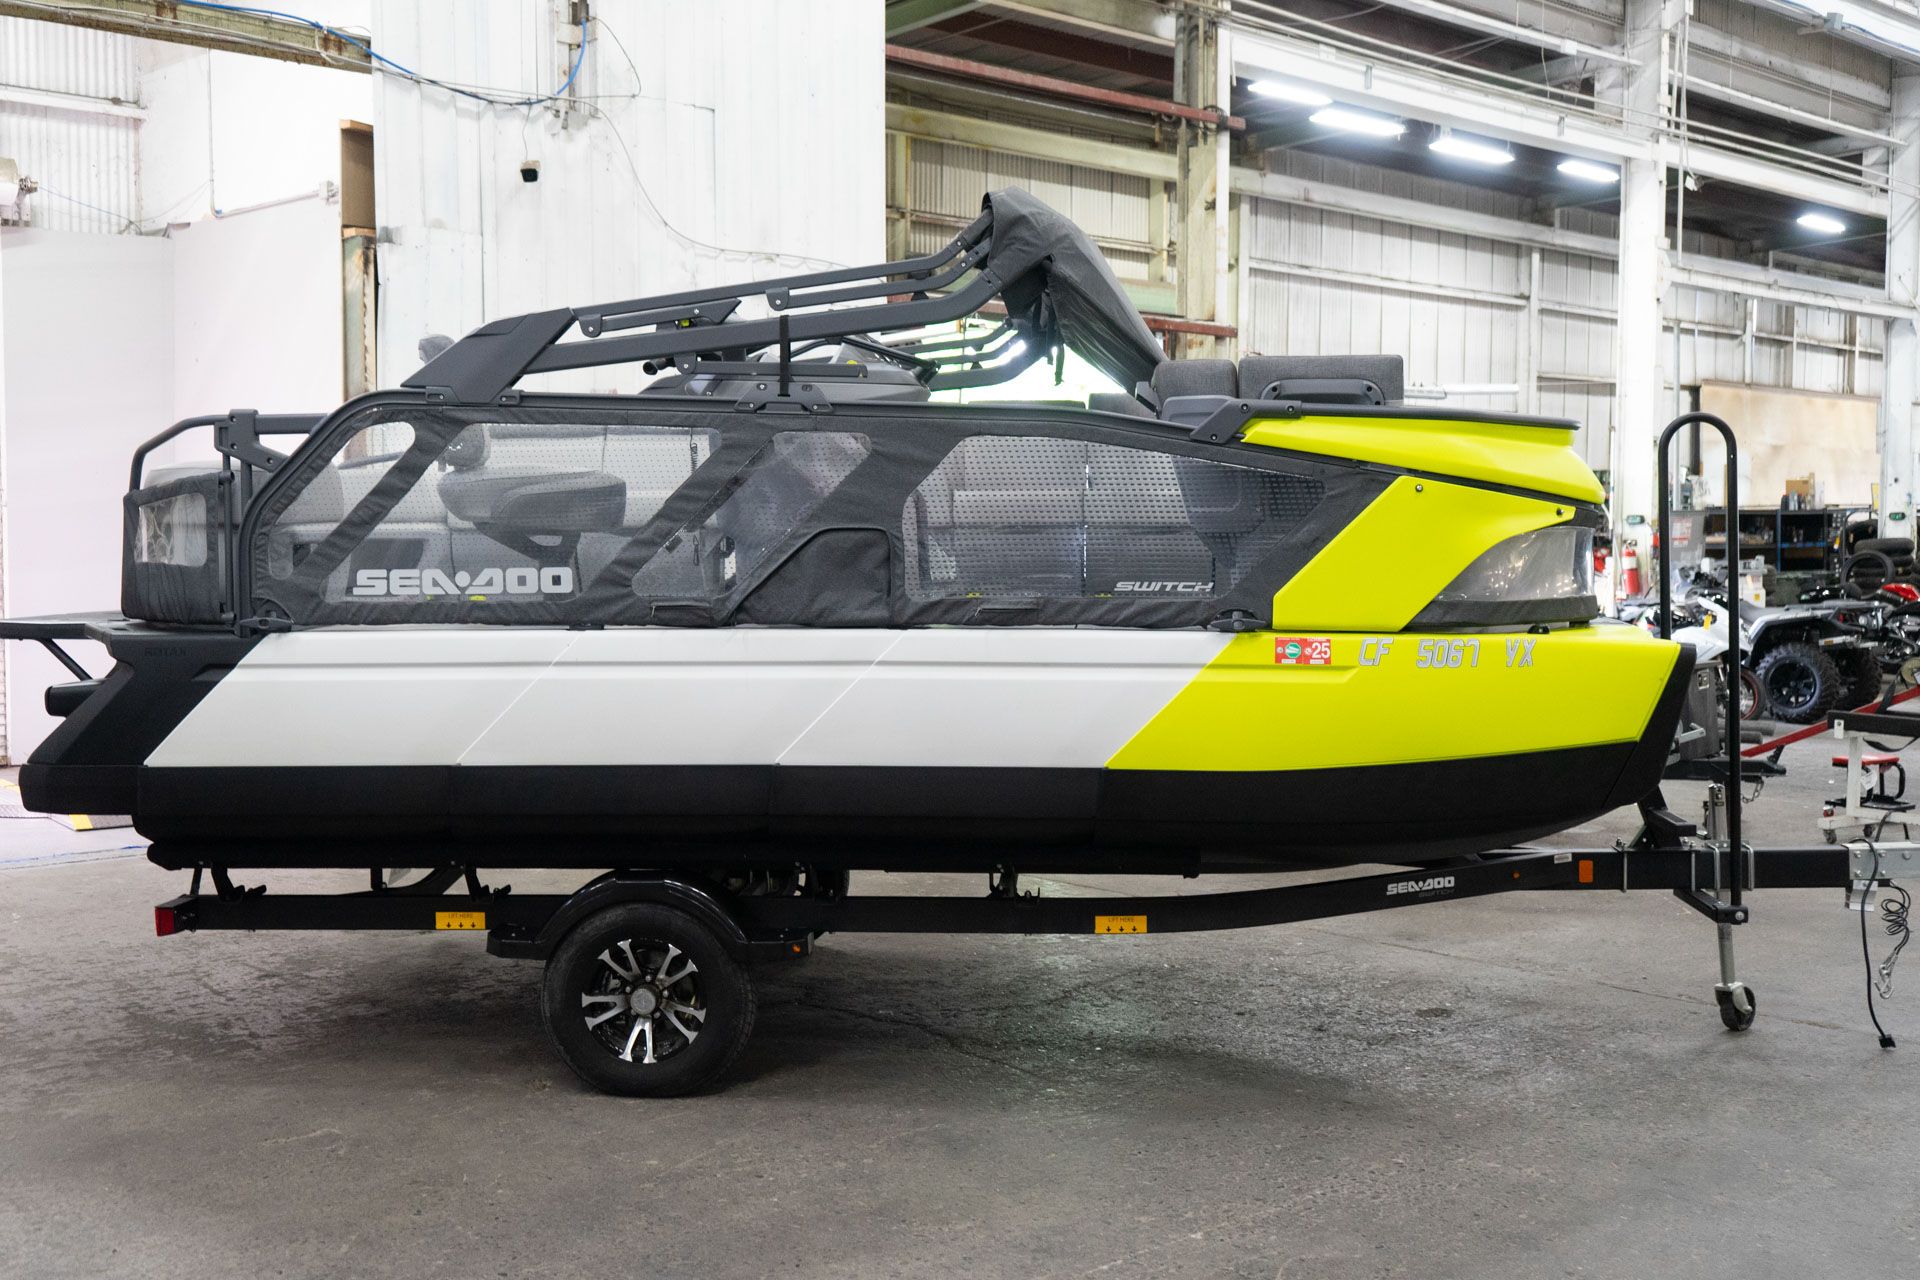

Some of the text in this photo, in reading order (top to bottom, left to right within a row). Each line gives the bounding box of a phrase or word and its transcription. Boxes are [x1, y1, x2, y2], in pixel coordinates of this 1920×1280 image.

[1114, 582, 1214, 592] SWITCH
[1311, 642, 1331, 659] 25
[1358, 637, 1394, 666] CF
[1416, 638, 1480, 668] 5067
